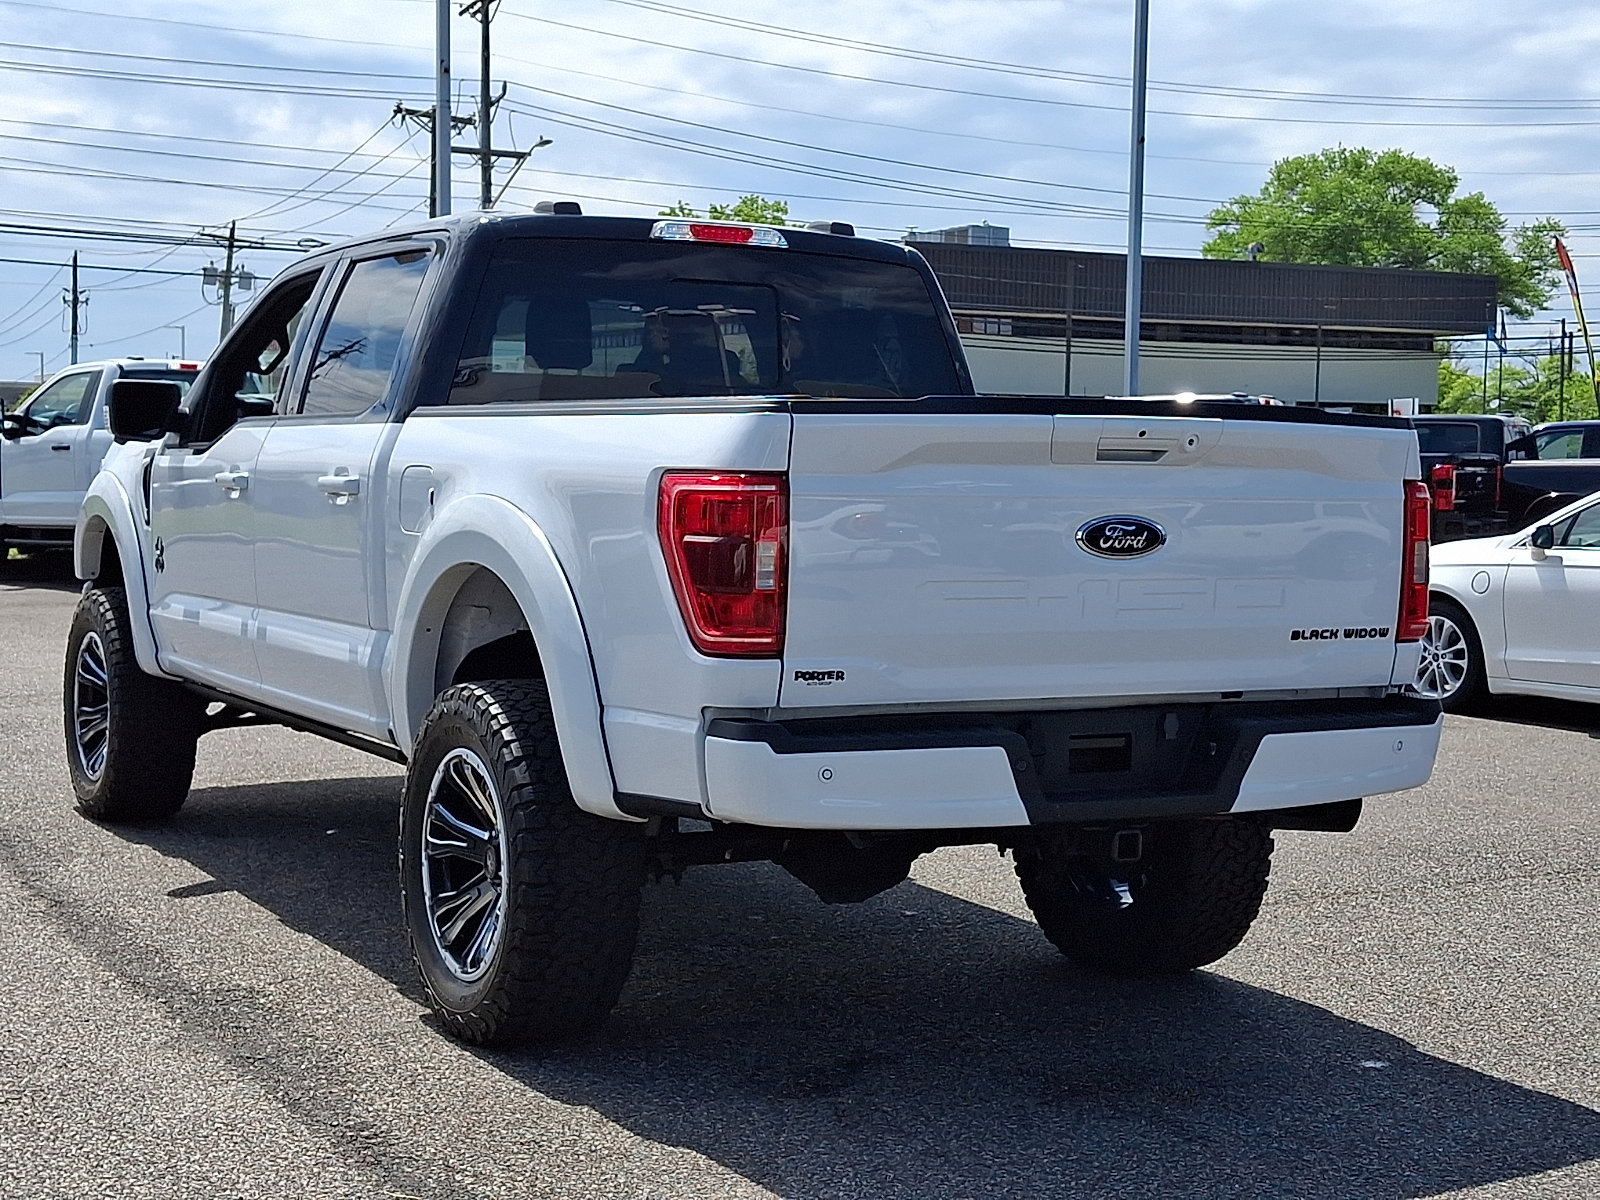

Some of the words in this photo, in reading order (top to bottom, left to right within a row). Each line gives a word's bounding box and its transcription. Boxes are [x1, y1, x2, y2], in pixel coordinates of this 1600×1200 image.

[1100, 524, 1147, 548] Ford
[1290, 628, 1340, 641] BLACK
[1343, 627, 1390, 639] WIDOW
[794, 670, 845, 681] PORTER
